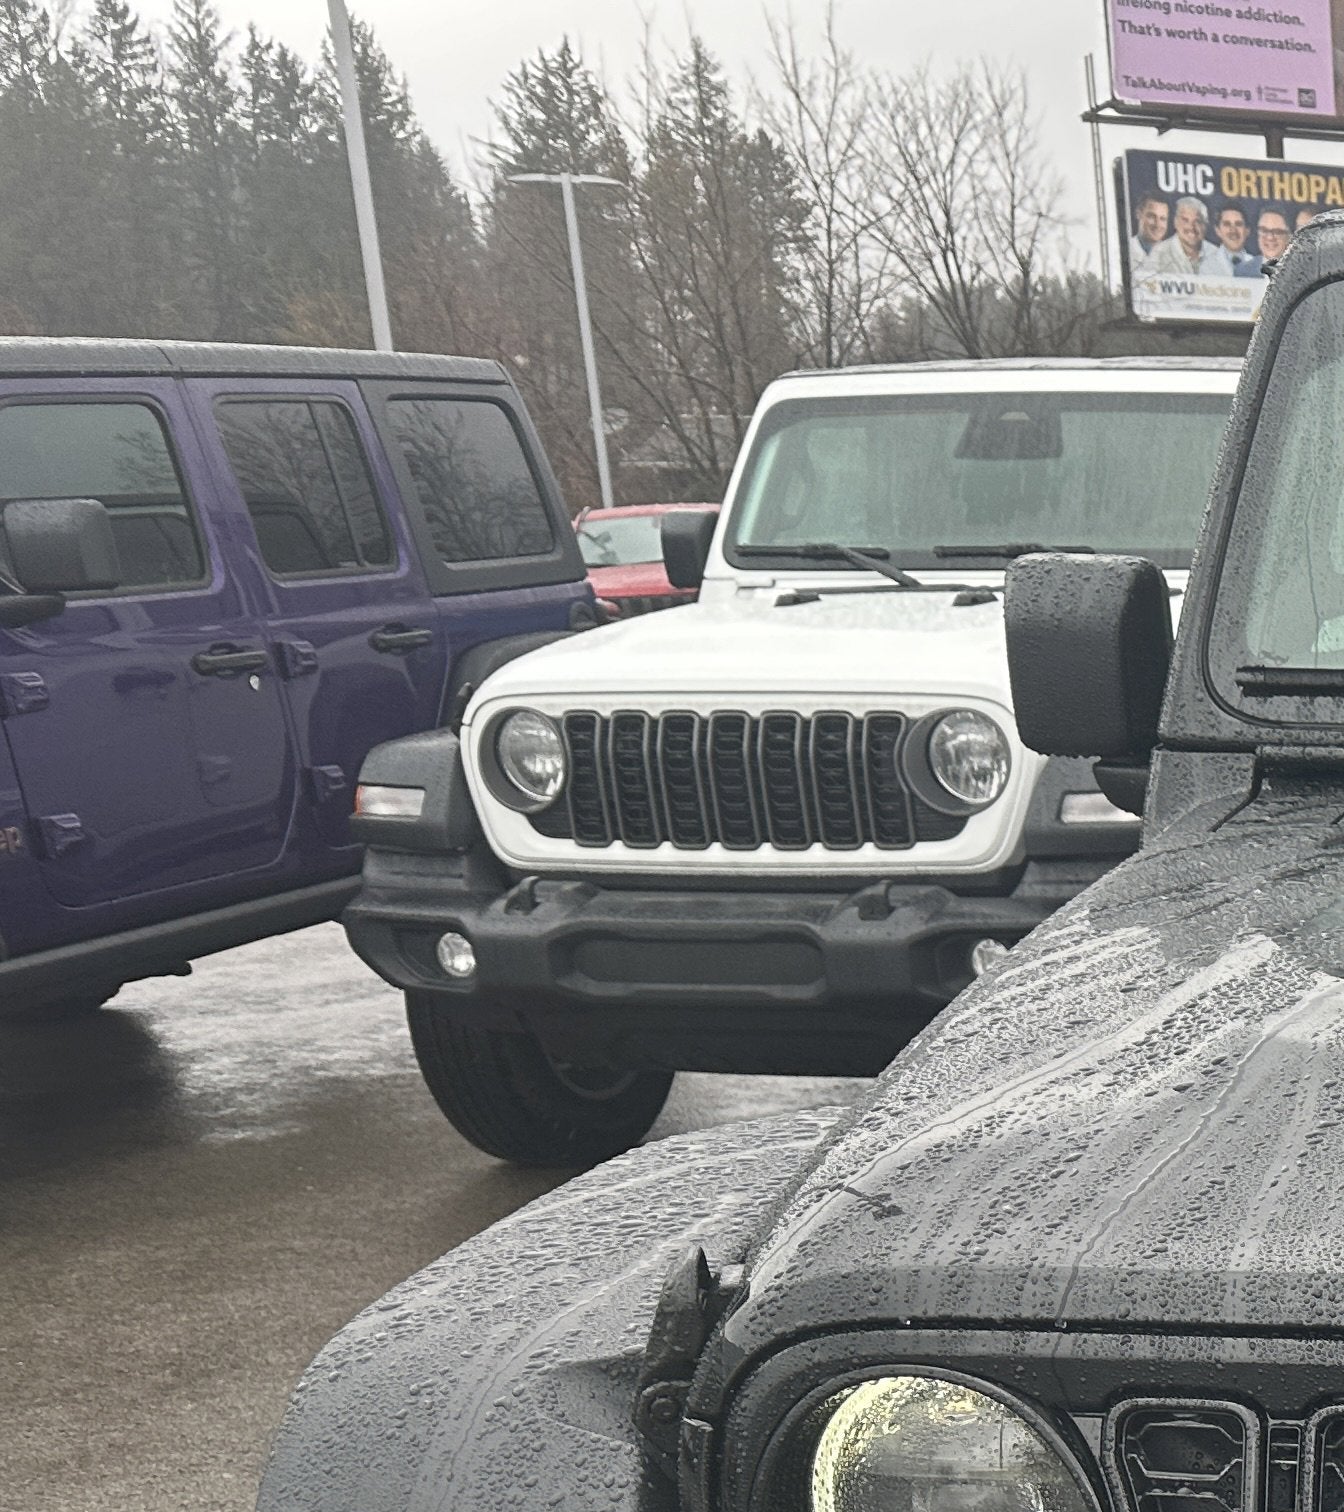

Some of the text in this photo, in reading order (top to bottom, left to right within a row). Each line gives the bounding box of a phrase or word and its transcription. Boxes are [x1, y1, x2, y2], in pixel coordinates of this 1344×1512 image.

[1174, 0, 1232, 18] nicotine
[1235, 6, 1305, 26] addiction.
[1117, 19, 1316, 52] That's worth a conversation.
[1122, 75, 1252, 100] TalkAboutVaping.org
[1156, 160, 1215, 195] UHC
[1160, 280, 1195, 295] WVU
